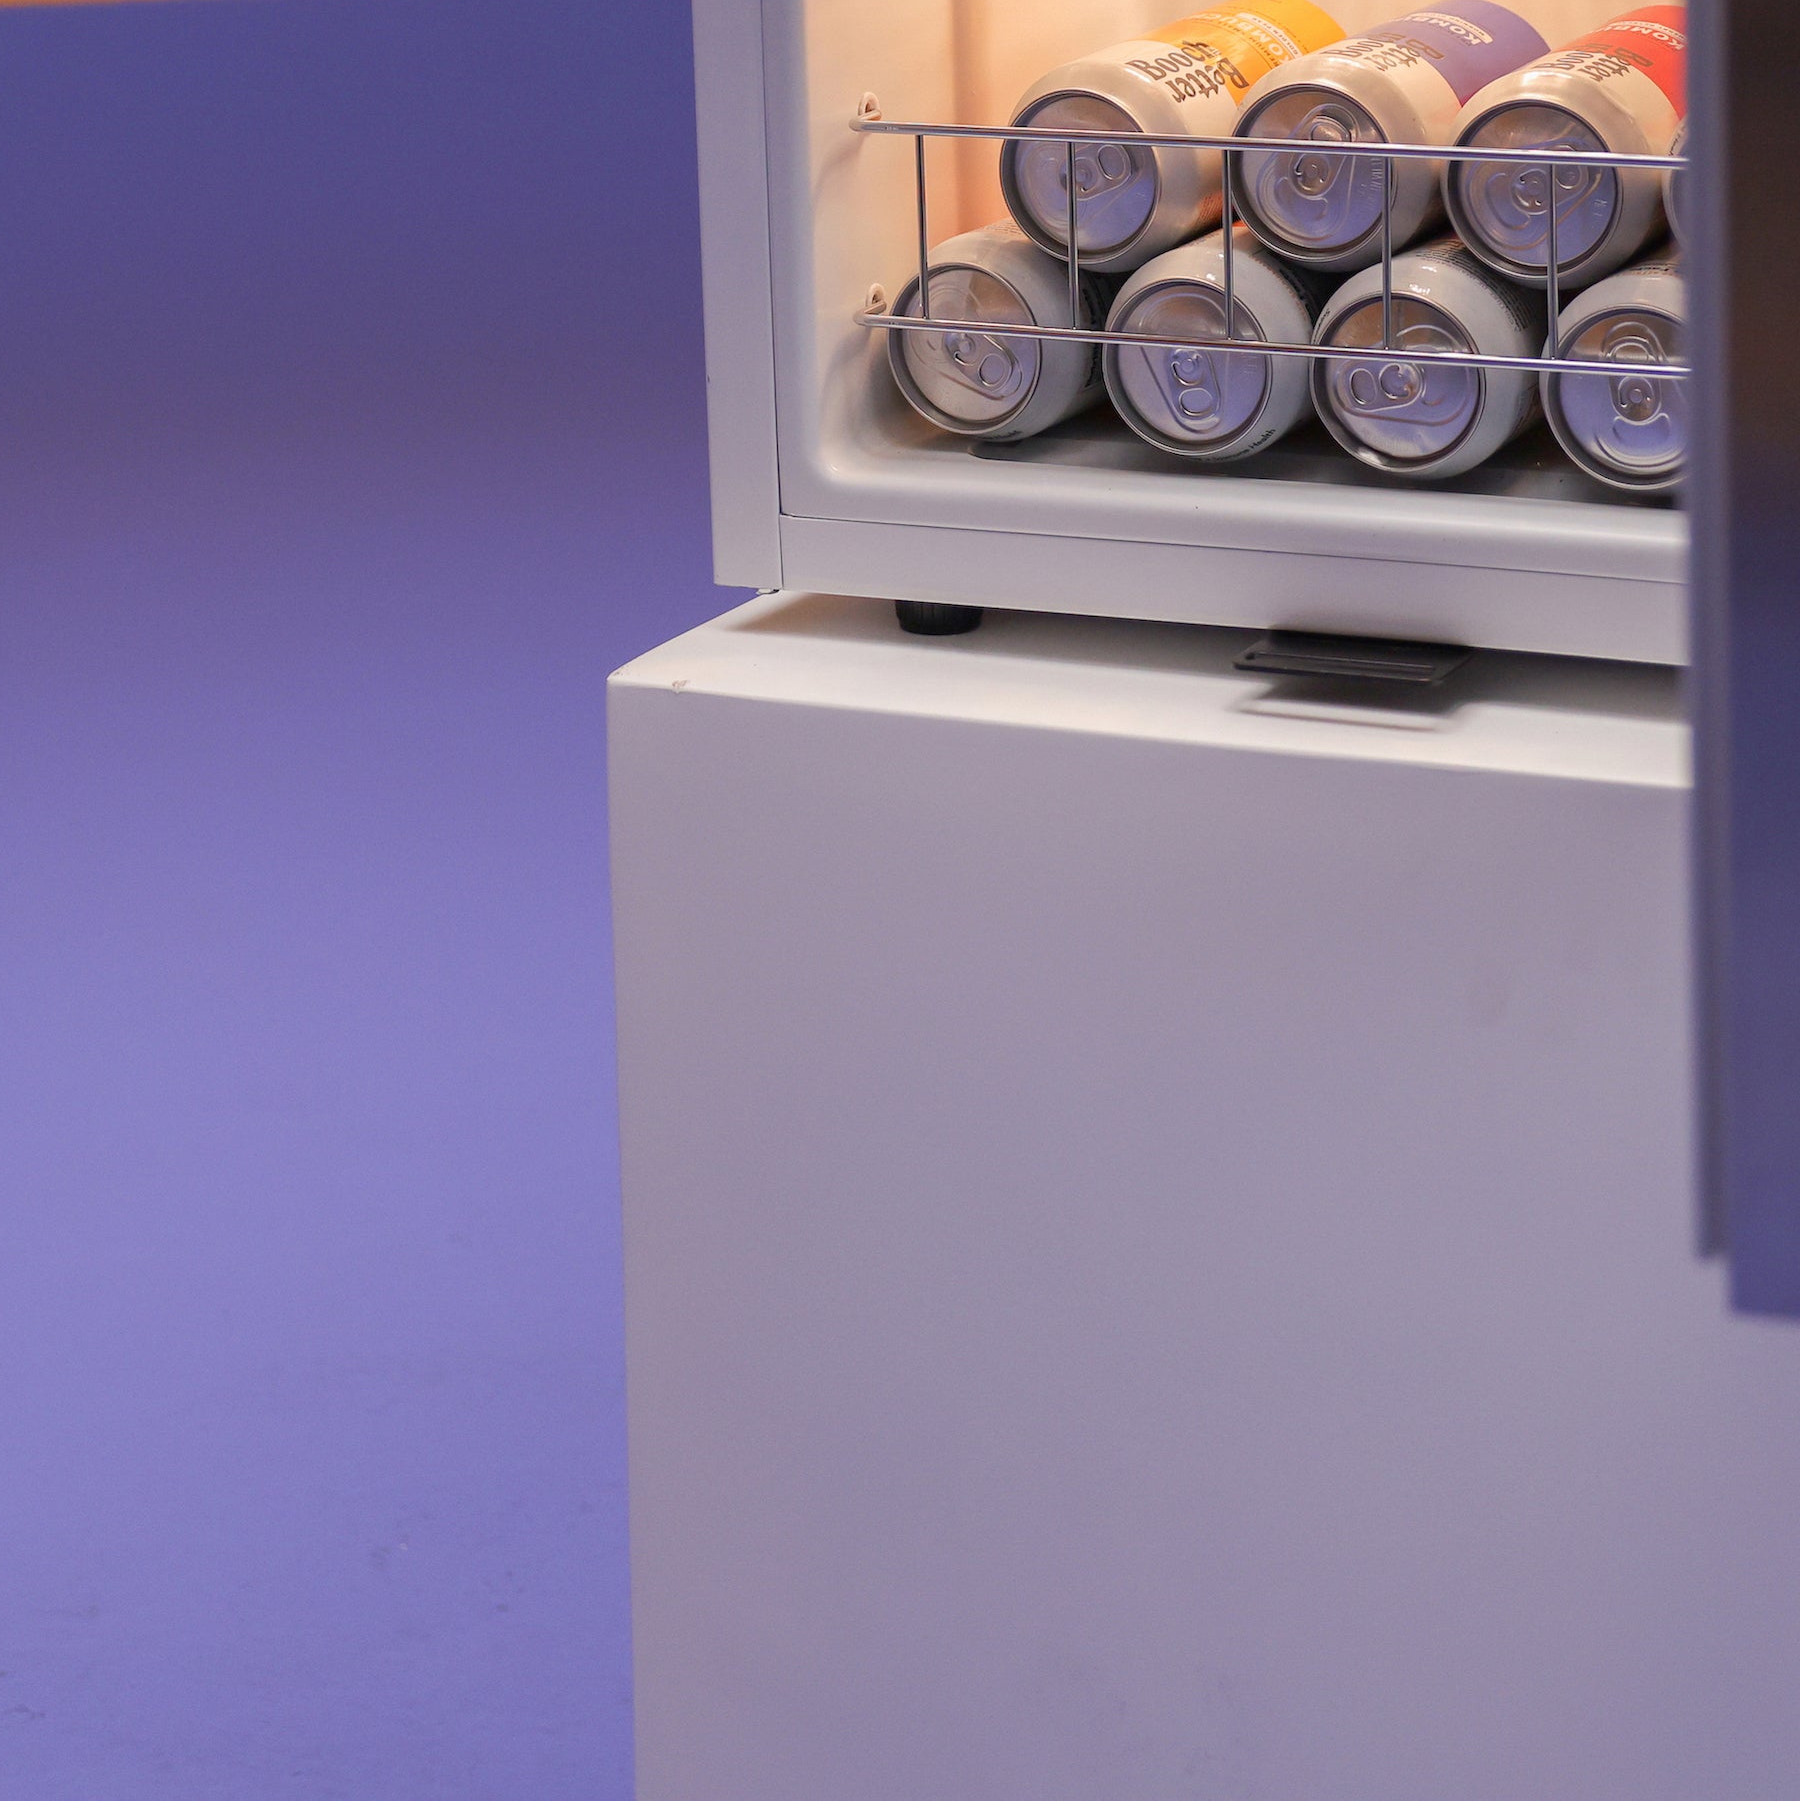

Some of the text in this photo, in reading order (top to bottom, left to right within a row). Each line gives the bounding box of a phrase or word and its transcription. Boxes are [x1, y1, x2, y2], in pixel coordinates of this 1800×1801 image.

[1124, 40, 1221, 81] Booch
[1322, 32, 1406, 58] Booch
[1364, 38, 1444, 72] Better
[1532, 43, 1613, 70] Booch
[1166, 58, 1250, 103] Better
[1578, 47, 1654, 83] Better
[1248, 429, 1277, 449] Health
